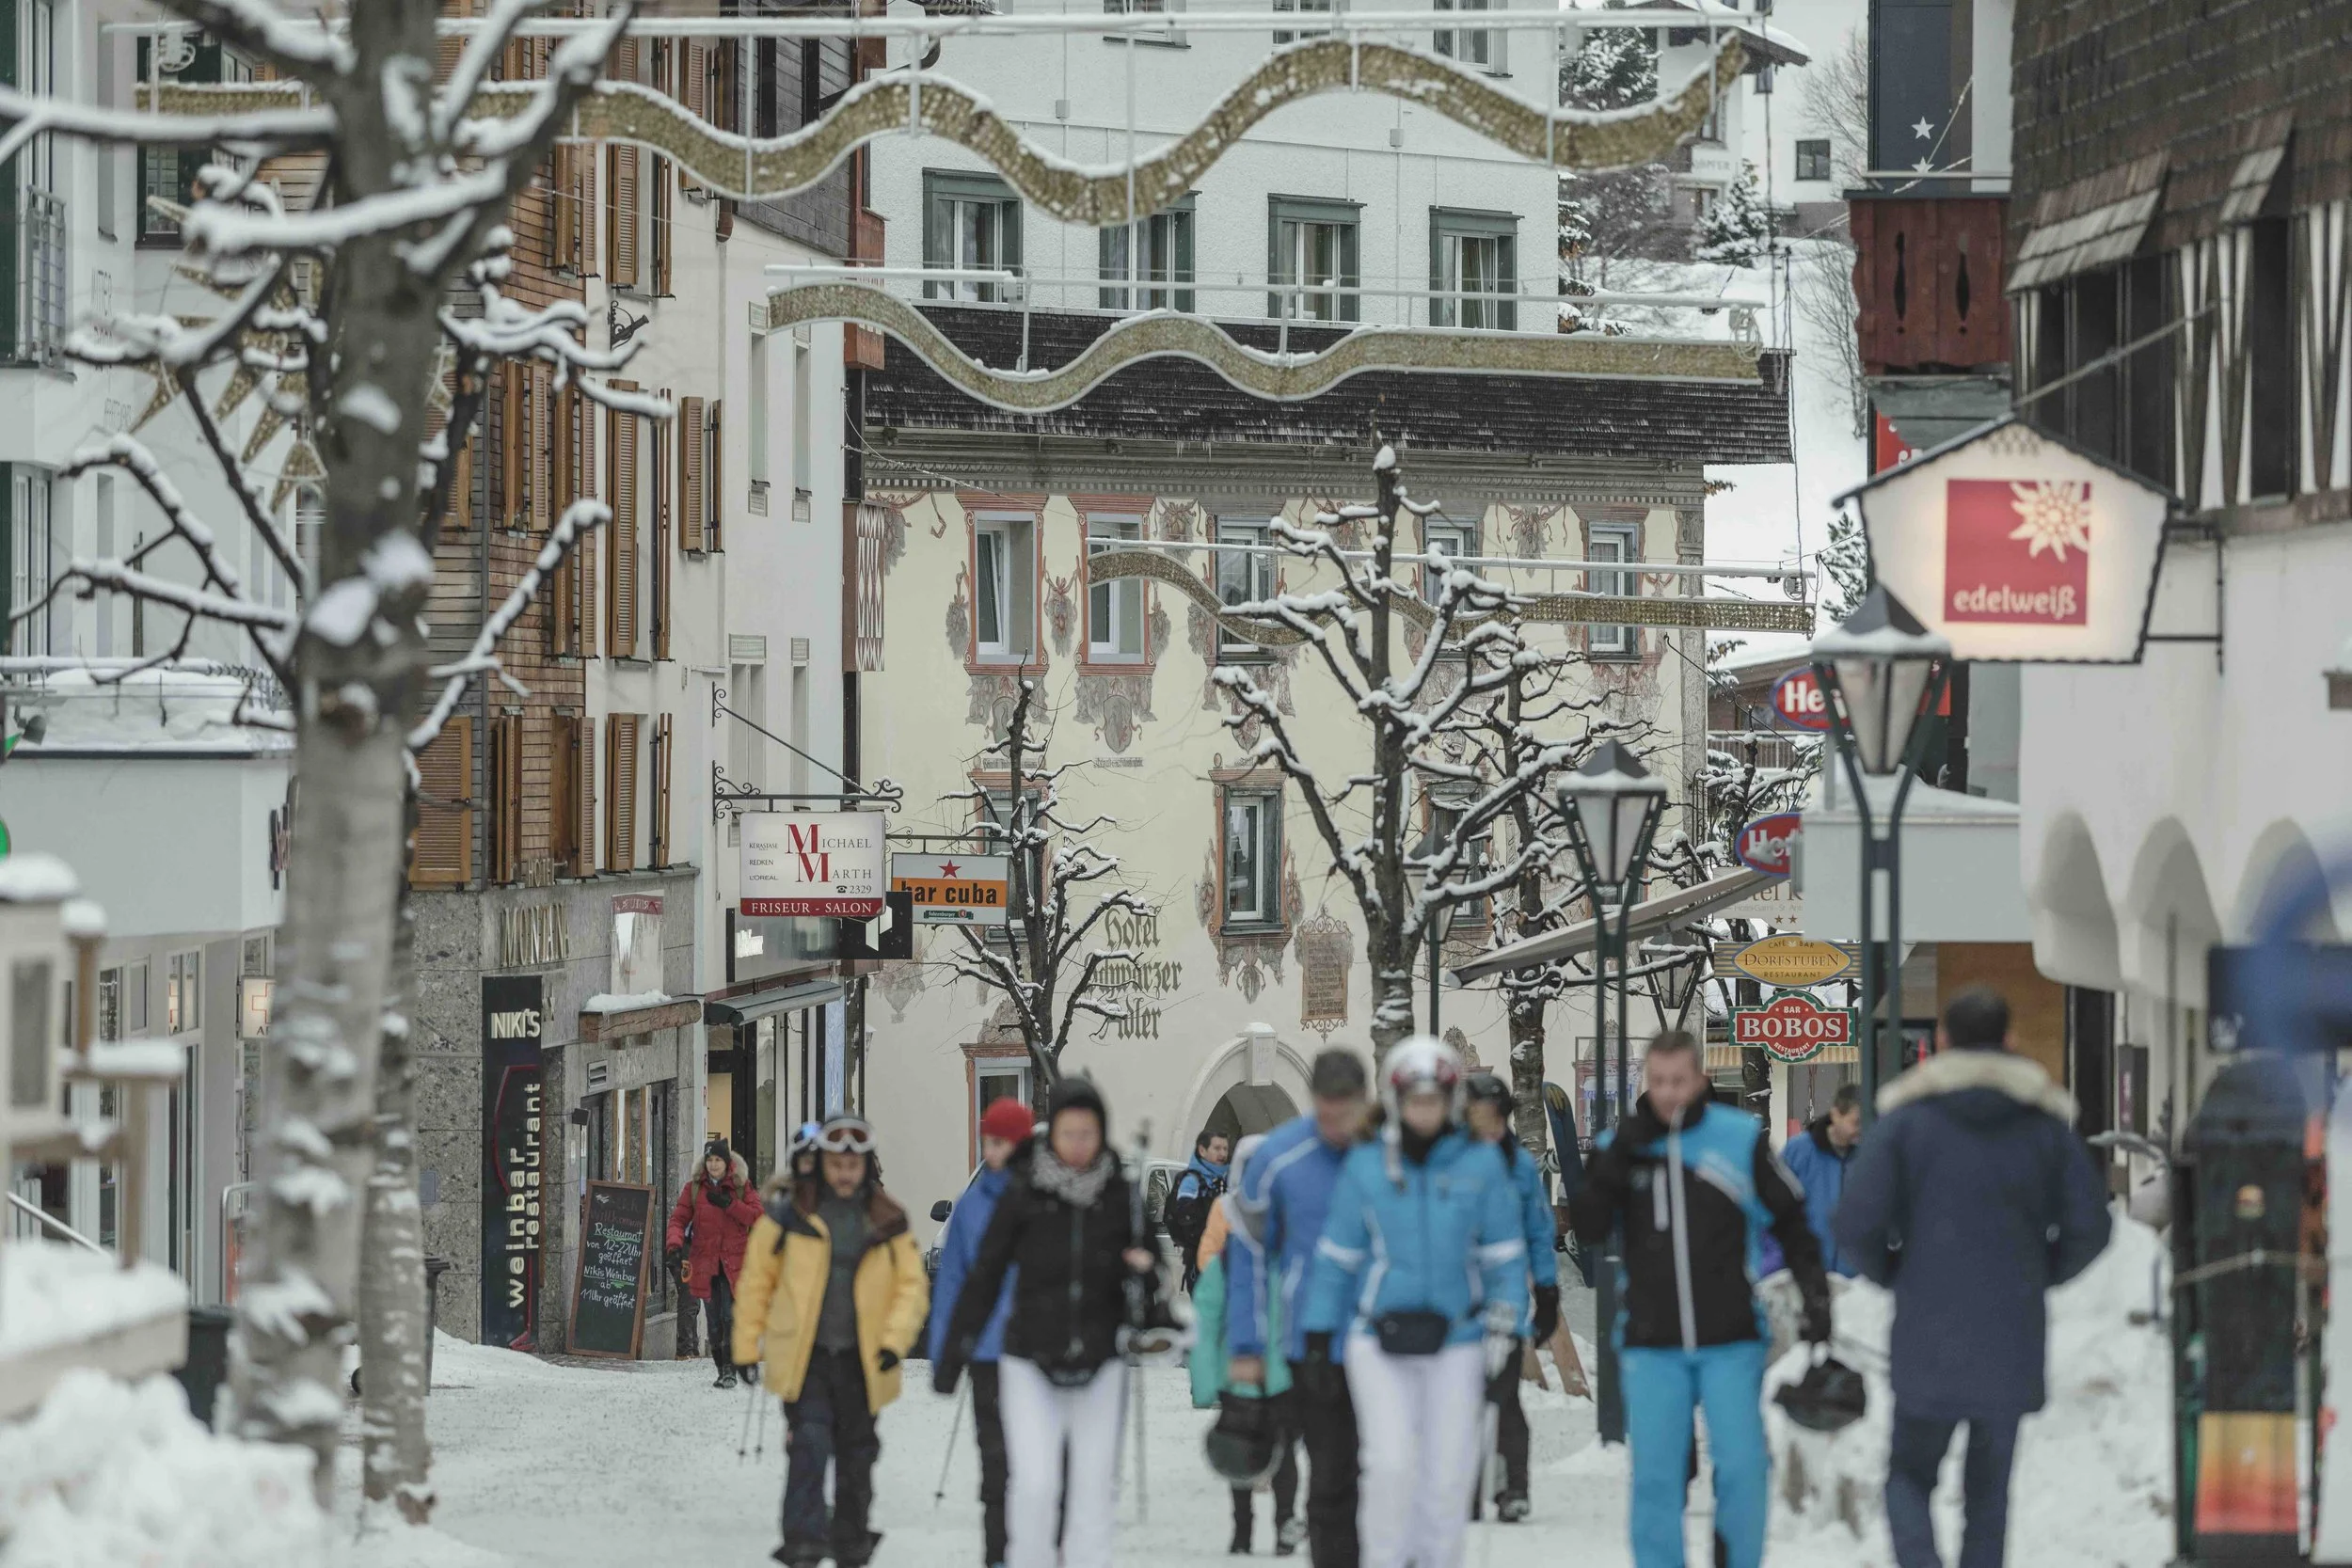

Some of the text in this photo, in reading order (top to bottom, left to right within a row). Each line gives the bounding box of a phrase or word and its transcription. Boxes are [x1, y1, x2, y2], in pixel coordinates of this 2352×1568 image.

[1953, 584, 2077, 619] edelweiß
[785, 824, 872, 854] MICHAEL
[795, 852, 871, 882] MARTH
[850, 885, 872, 894] 2329
[945, 883, 997, 904] cuba
[751, 902, 810, 913] FRISEUR
[824, 902, 872, 913] SALON
[1104, 906, 1161, 950] Hotel
[1799, 940, 1815, 948] BAR
[1744, 953, 1840, 966] DORFSTUBEN
[1742, 1017, 1841, 1037] BOBOS
[1773, 1041, 1810, 1053] RESTAURANT
[524, 1083, 541, 1249] restaurant
[505, 1147, 526, 1308] weinbar
[595, 1222, 644, 1241] Restaurant
[586, 1240, 600, 1249] von
[598, 1252, 633, 1266] geöffnet
[584, 1264, 637, 1283] Nikis Weinbar
[599, 1280, 612, 1290] ab
[603, 1291, 636, 1309] geöffnet
